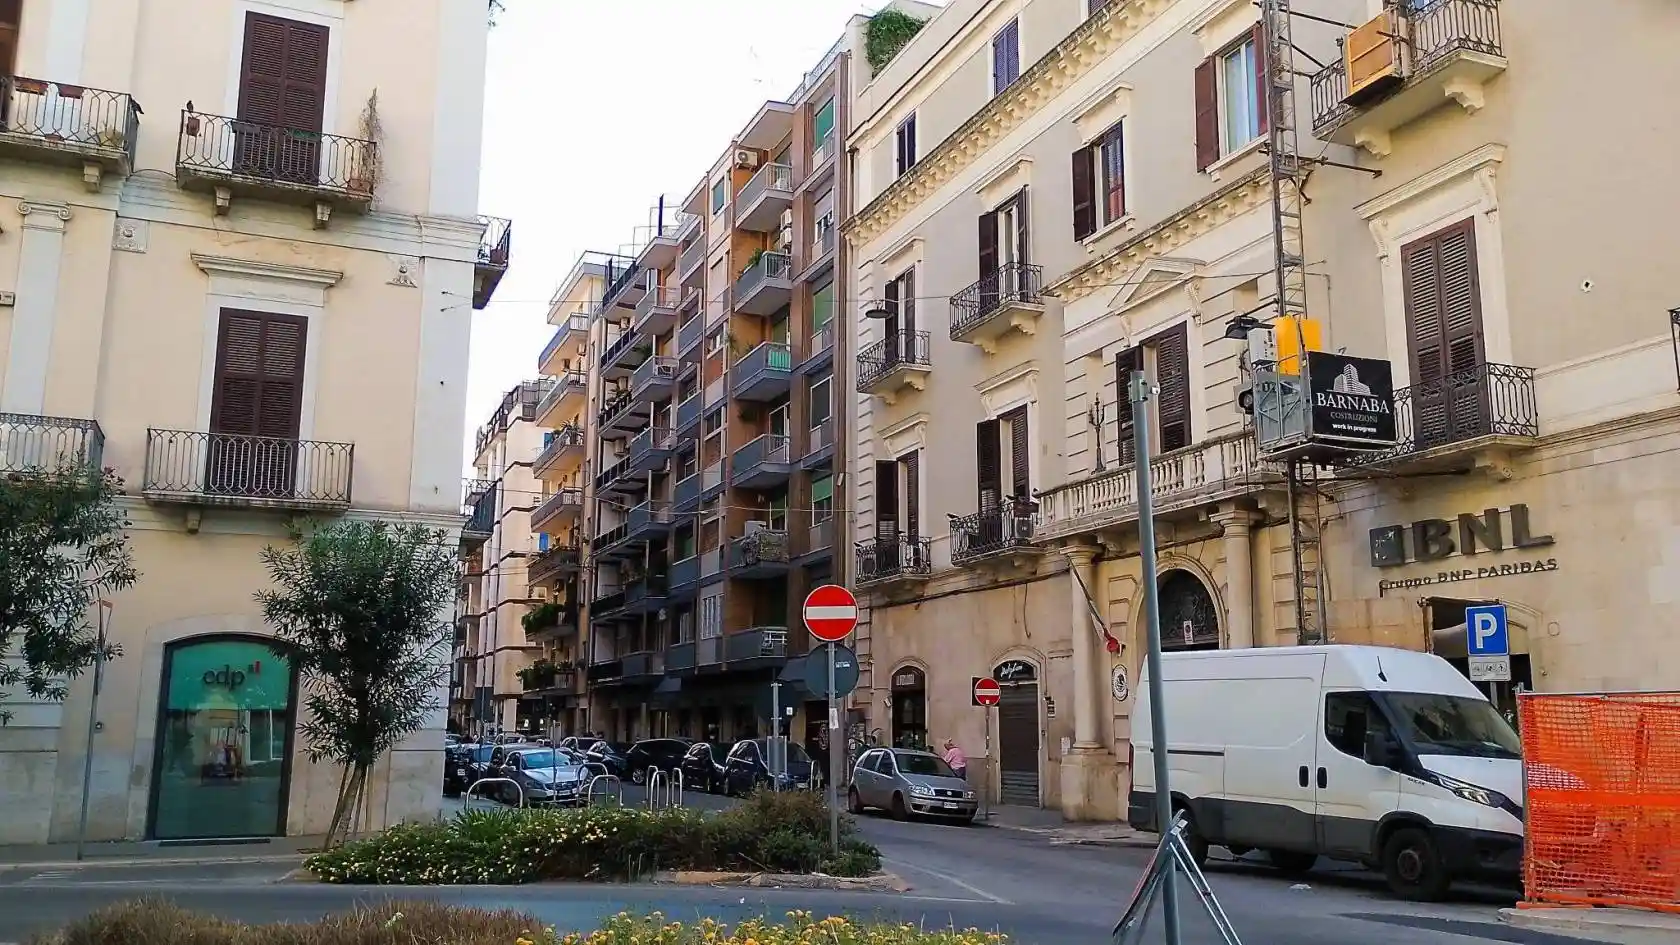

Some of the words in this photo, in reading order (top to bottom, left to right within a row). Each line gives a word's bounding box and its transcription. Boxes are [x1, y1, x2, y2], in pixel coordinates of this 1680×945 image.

[1316, 392, 1390, 414] BARNABA
[1330, 411, 1378, 423] COSTRUZIONI
[1353, 425, 1377, 433] progress
[1412, 503, 1556, 562] BNL
[1379, 576, 1432, 590] Gruppo
[1437, 568, 1473, 584] BNP
[1477, 558, 1559, 580] PARIBAS
[1474, 612, 1498, 649] P
